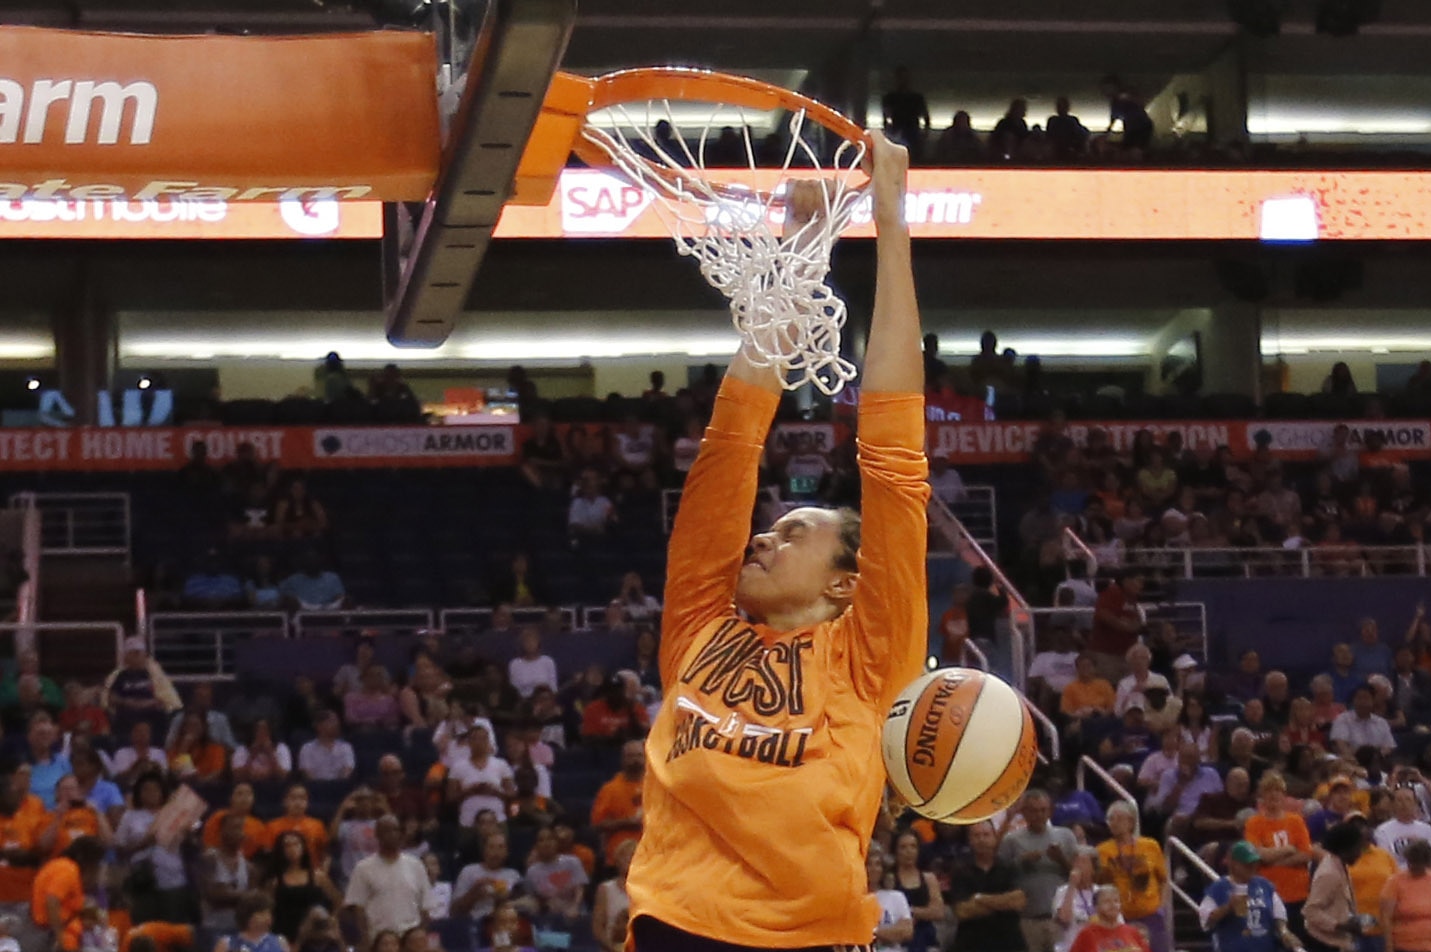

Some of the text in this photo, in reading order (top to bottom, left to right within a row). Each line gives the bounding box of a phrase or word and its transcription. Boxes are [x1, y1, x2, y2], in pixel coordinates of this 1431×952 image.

[132, 180, 371, 200] Farm
[566, 186, 644, 219] SAP
[80, 430, 174, 459] HOME
